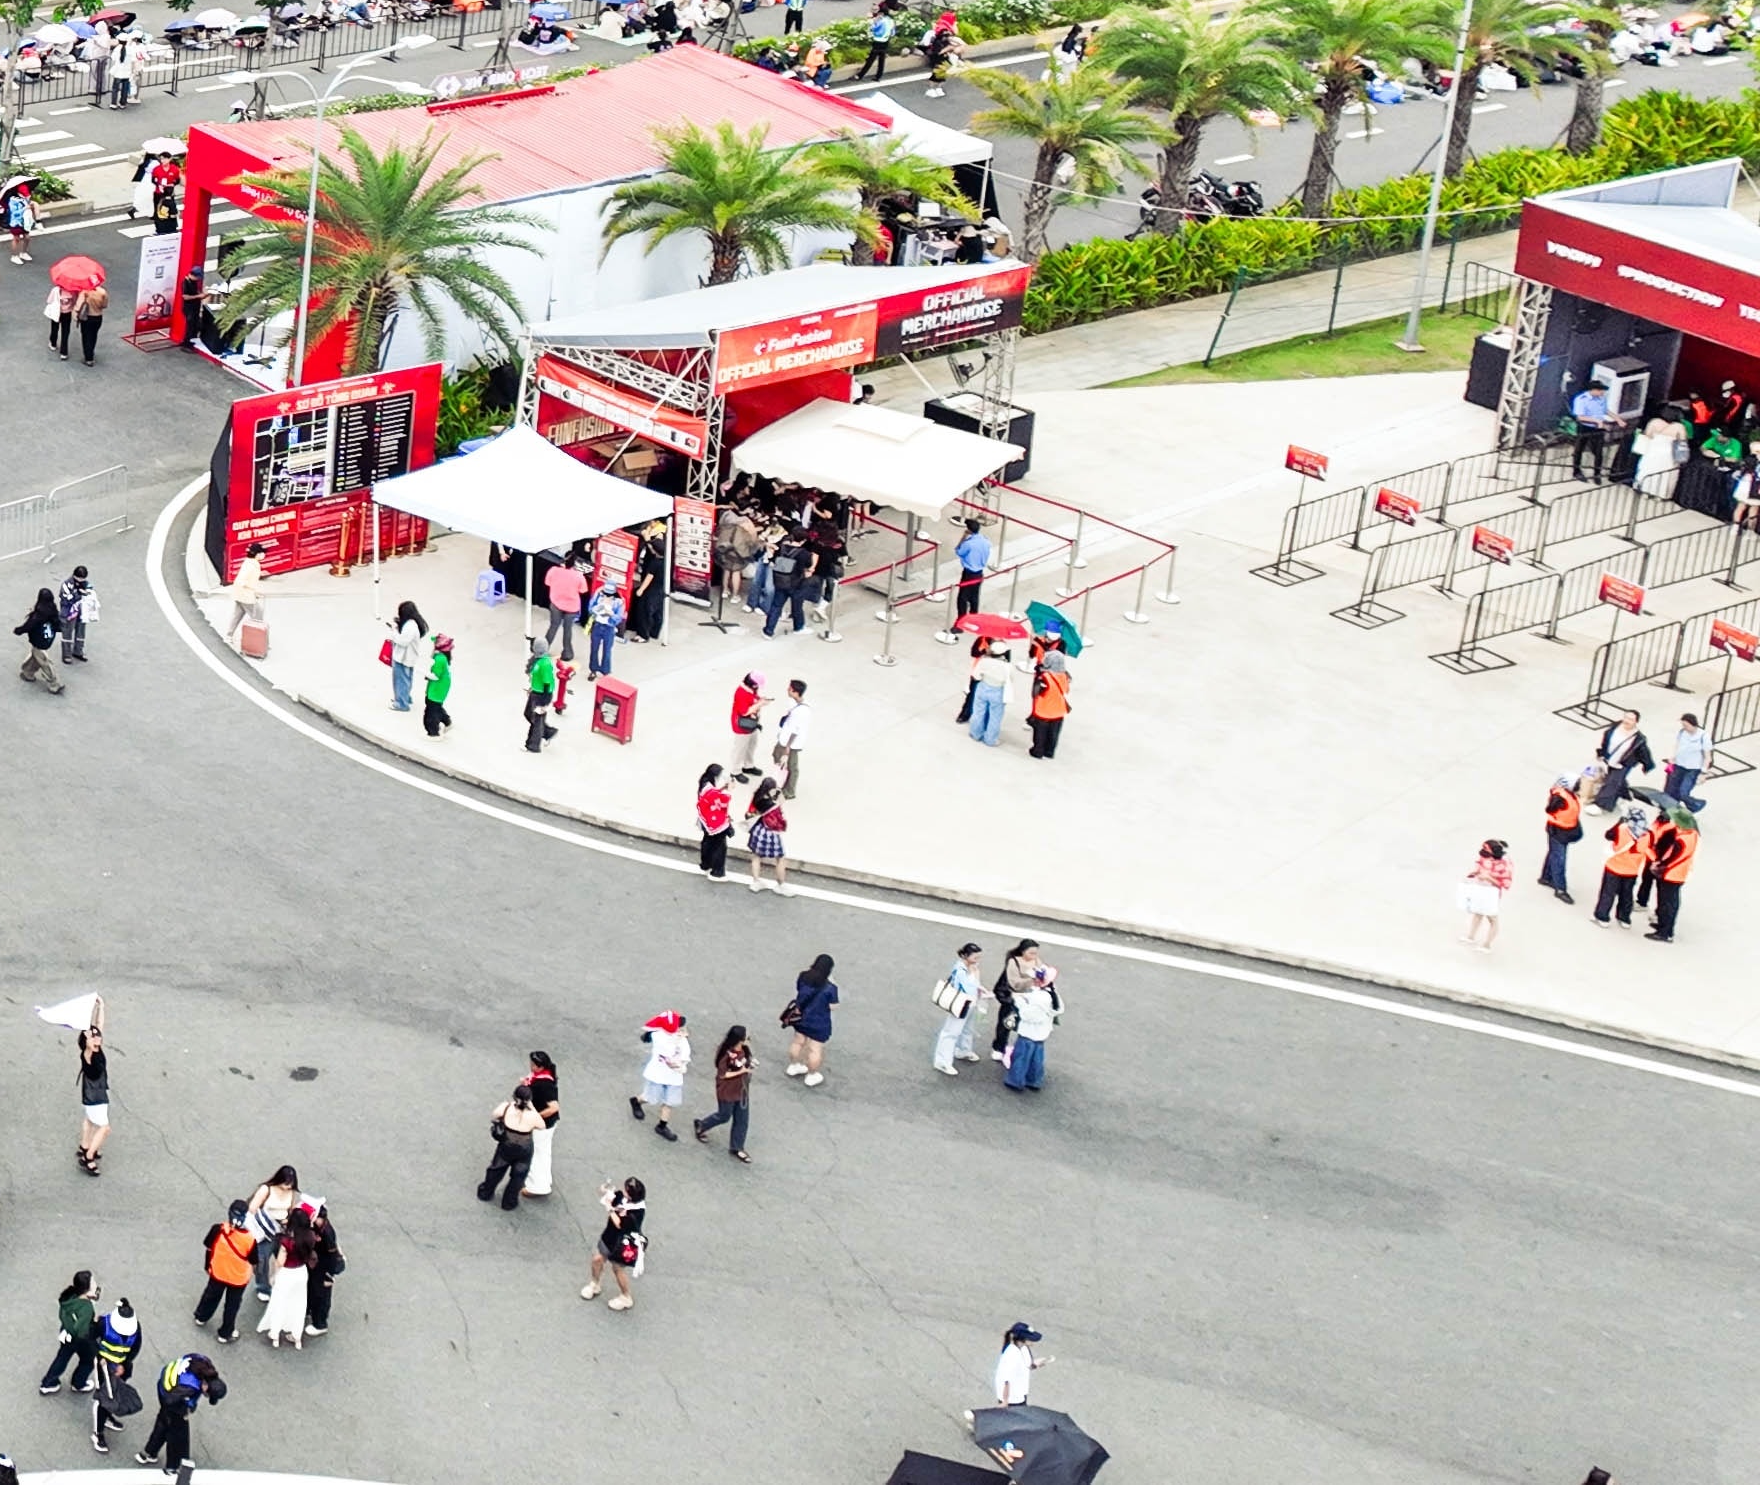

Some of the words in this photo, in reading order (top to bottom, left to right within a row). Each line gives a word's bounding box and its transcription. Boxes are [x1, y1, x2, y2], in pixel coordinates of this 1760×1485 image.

[922, 285, 986, 313] OFFICIAL
[901, 299, 1004, 337] MERCHANDISE
[767, 329, 832, 353] FunFusion
[718, 357, 773, 384] OFFICIAL
[775, 338, 865, 370] MERCHANDISE
